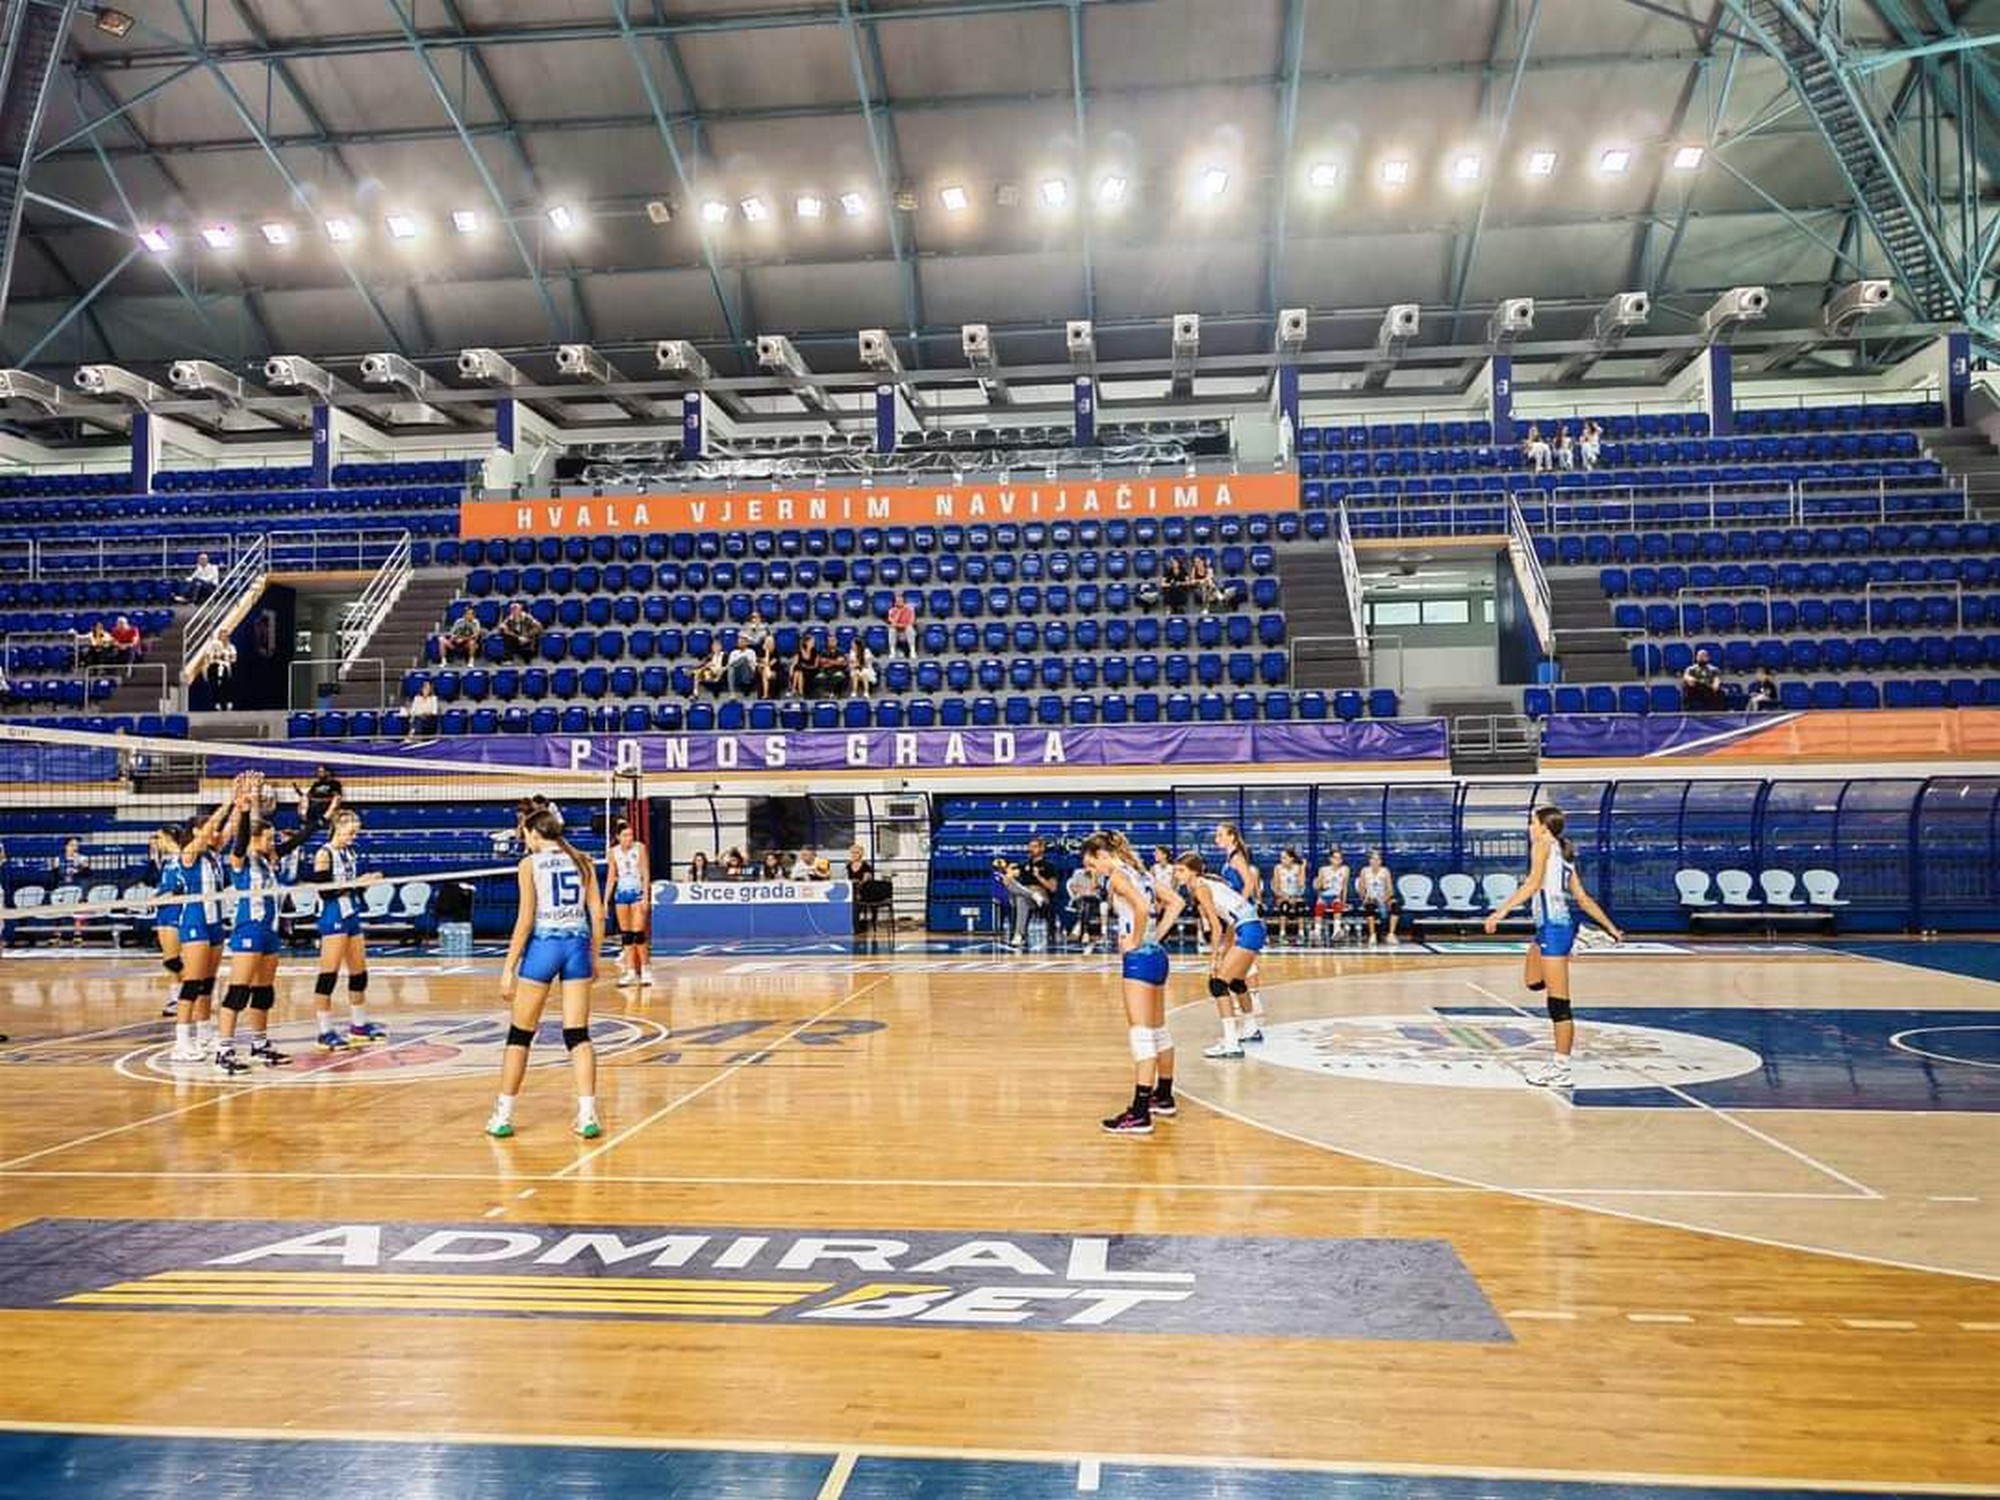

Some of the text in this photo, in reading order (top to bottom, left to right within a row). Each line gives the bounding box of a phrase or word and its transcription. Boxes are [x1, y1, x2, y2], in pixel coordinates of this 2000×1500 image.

[517, 483, 1232, 529] HVALA VJERNIM NAVIJAČIMA
[570, 730, 1067, 770] PONOS GRADA
[552, 871, 580, 907] 15
[689, 882, 796, 902] Srce grada
[202, 1224, 1196, 1284] ADMIRAL
[798, 1283, 1194, 1326] BET
